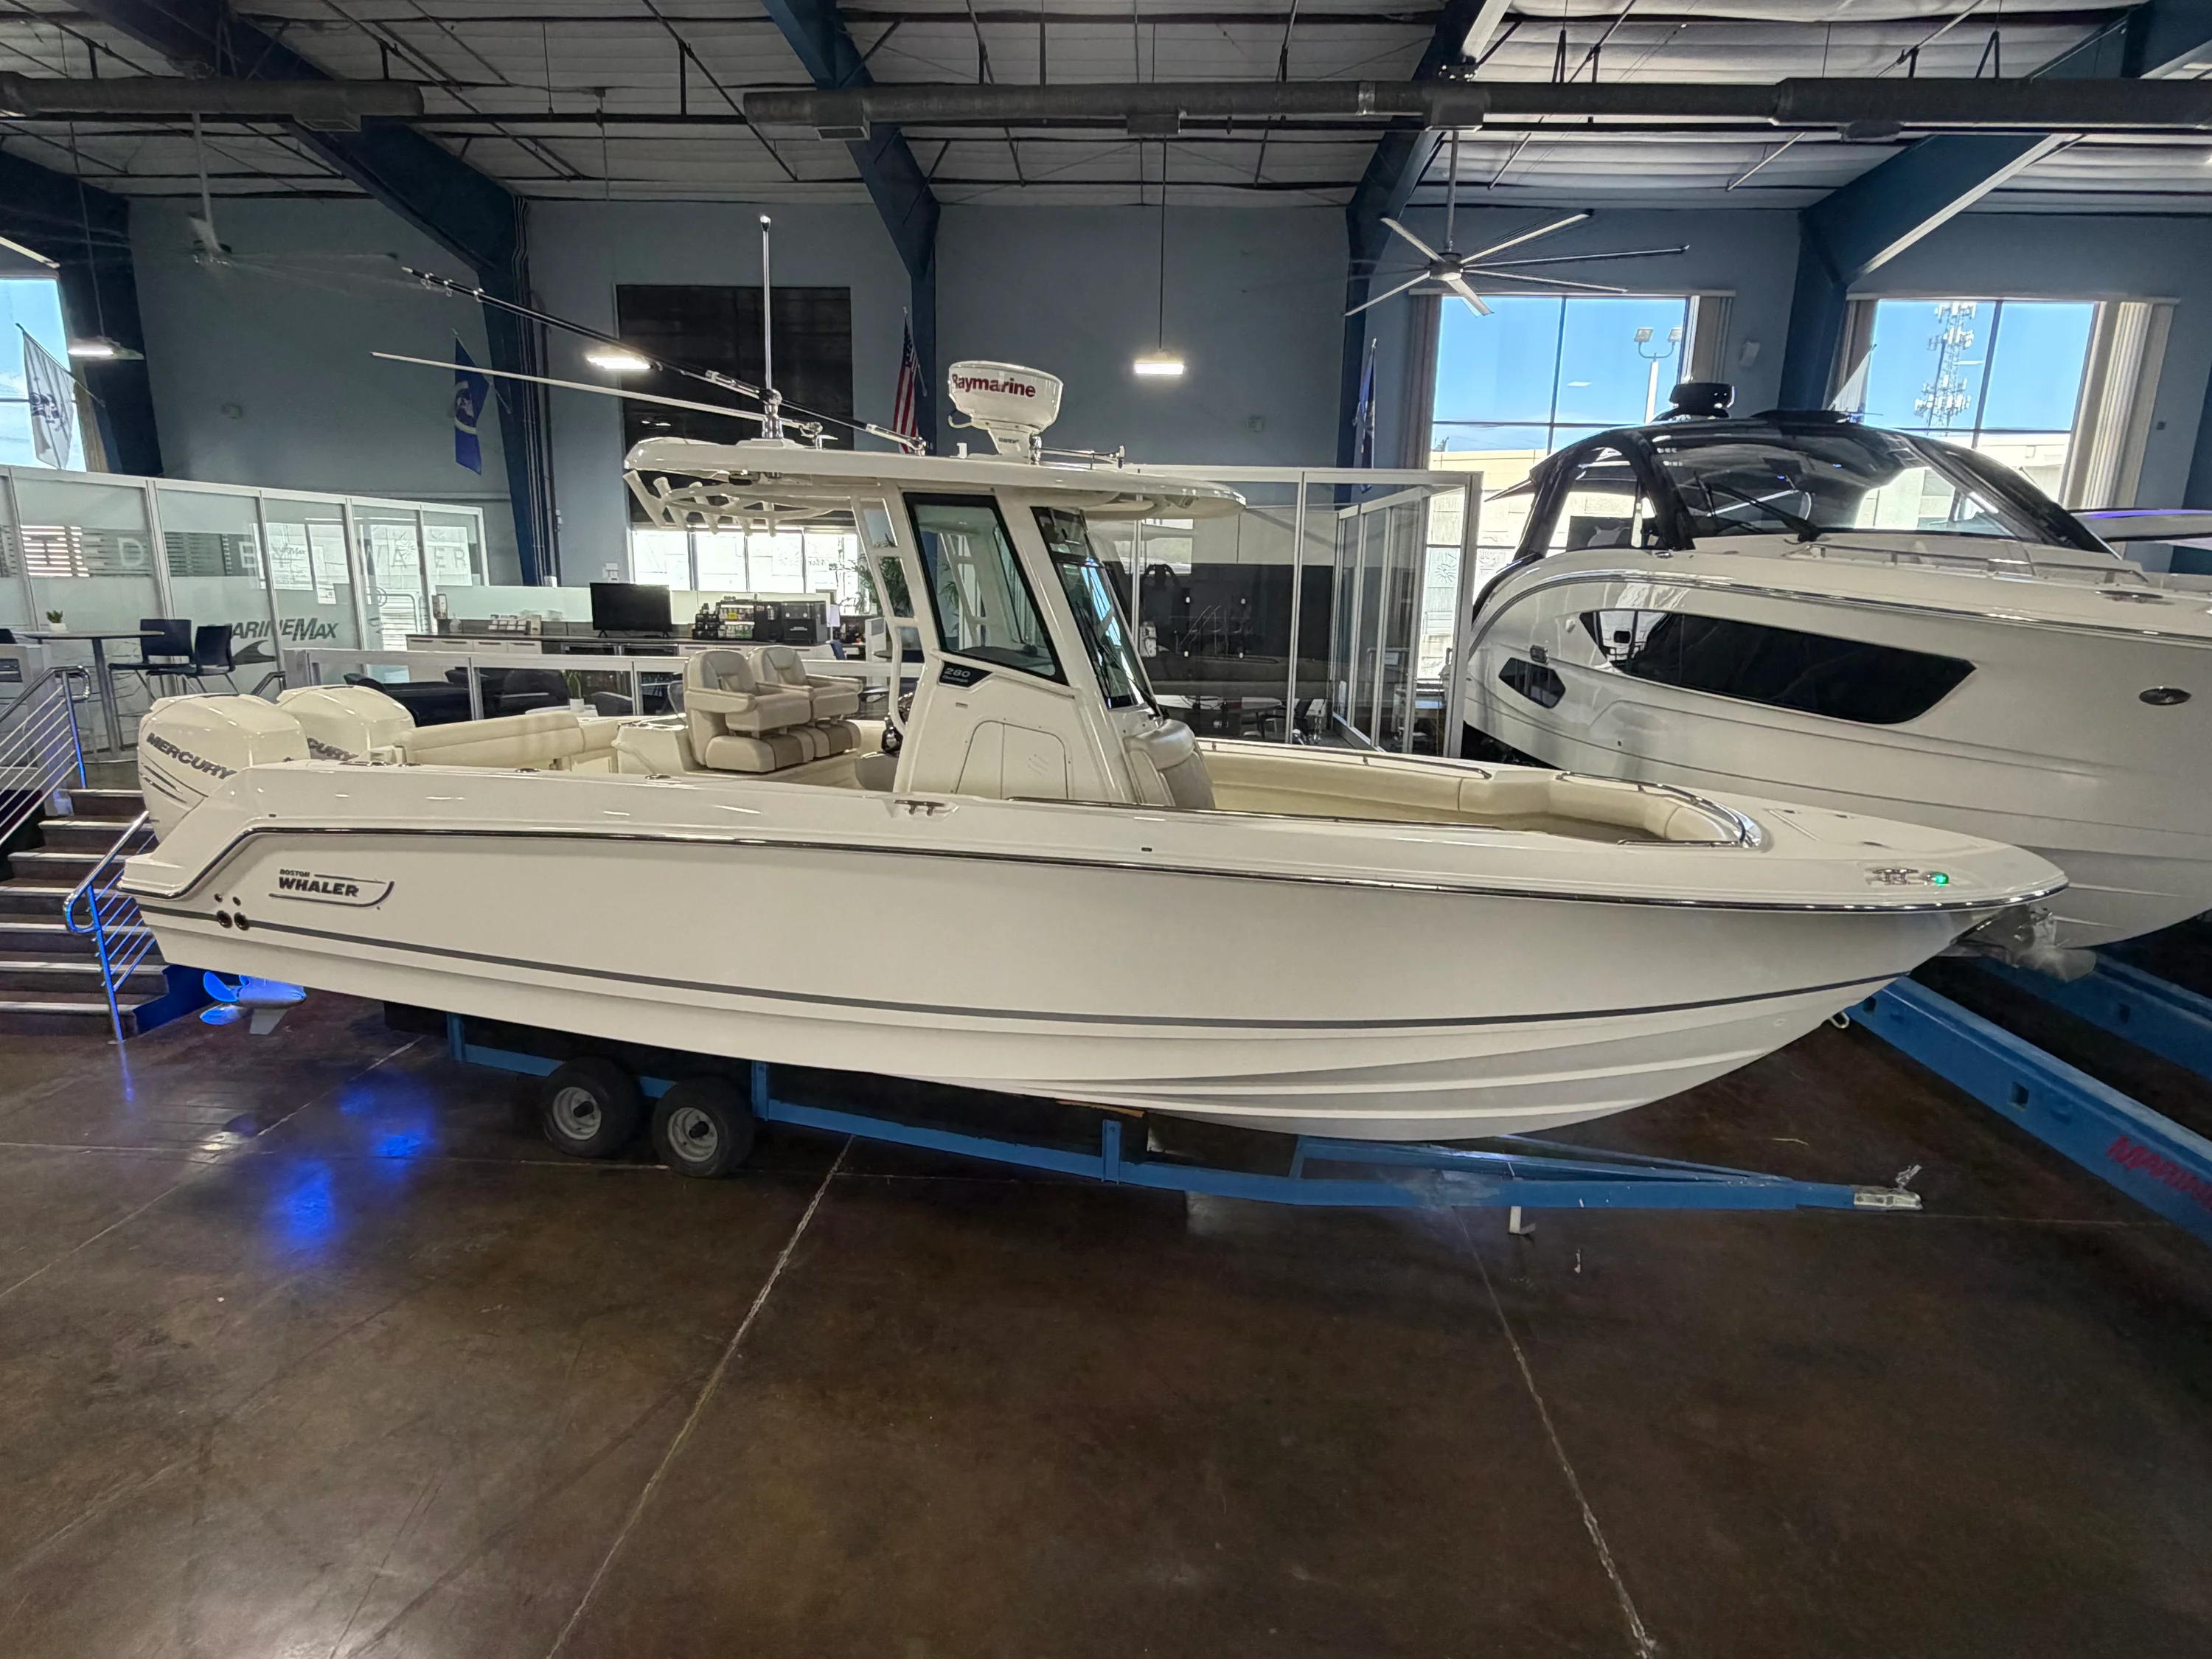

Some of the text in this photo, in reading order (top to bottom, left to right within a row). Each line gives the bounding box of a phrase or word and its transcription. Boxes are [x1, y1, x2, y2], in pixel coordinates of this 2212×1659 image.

[952, 373, 1036, 397] Raymarine
[944, 667, 971, 678] 280
[147, 732, 237, 779] MERCURY
[307, 737, 359, 761] CURY
[279, 869, 310, 877] BOSTON
[279, 877, 360, 897] WHALER
